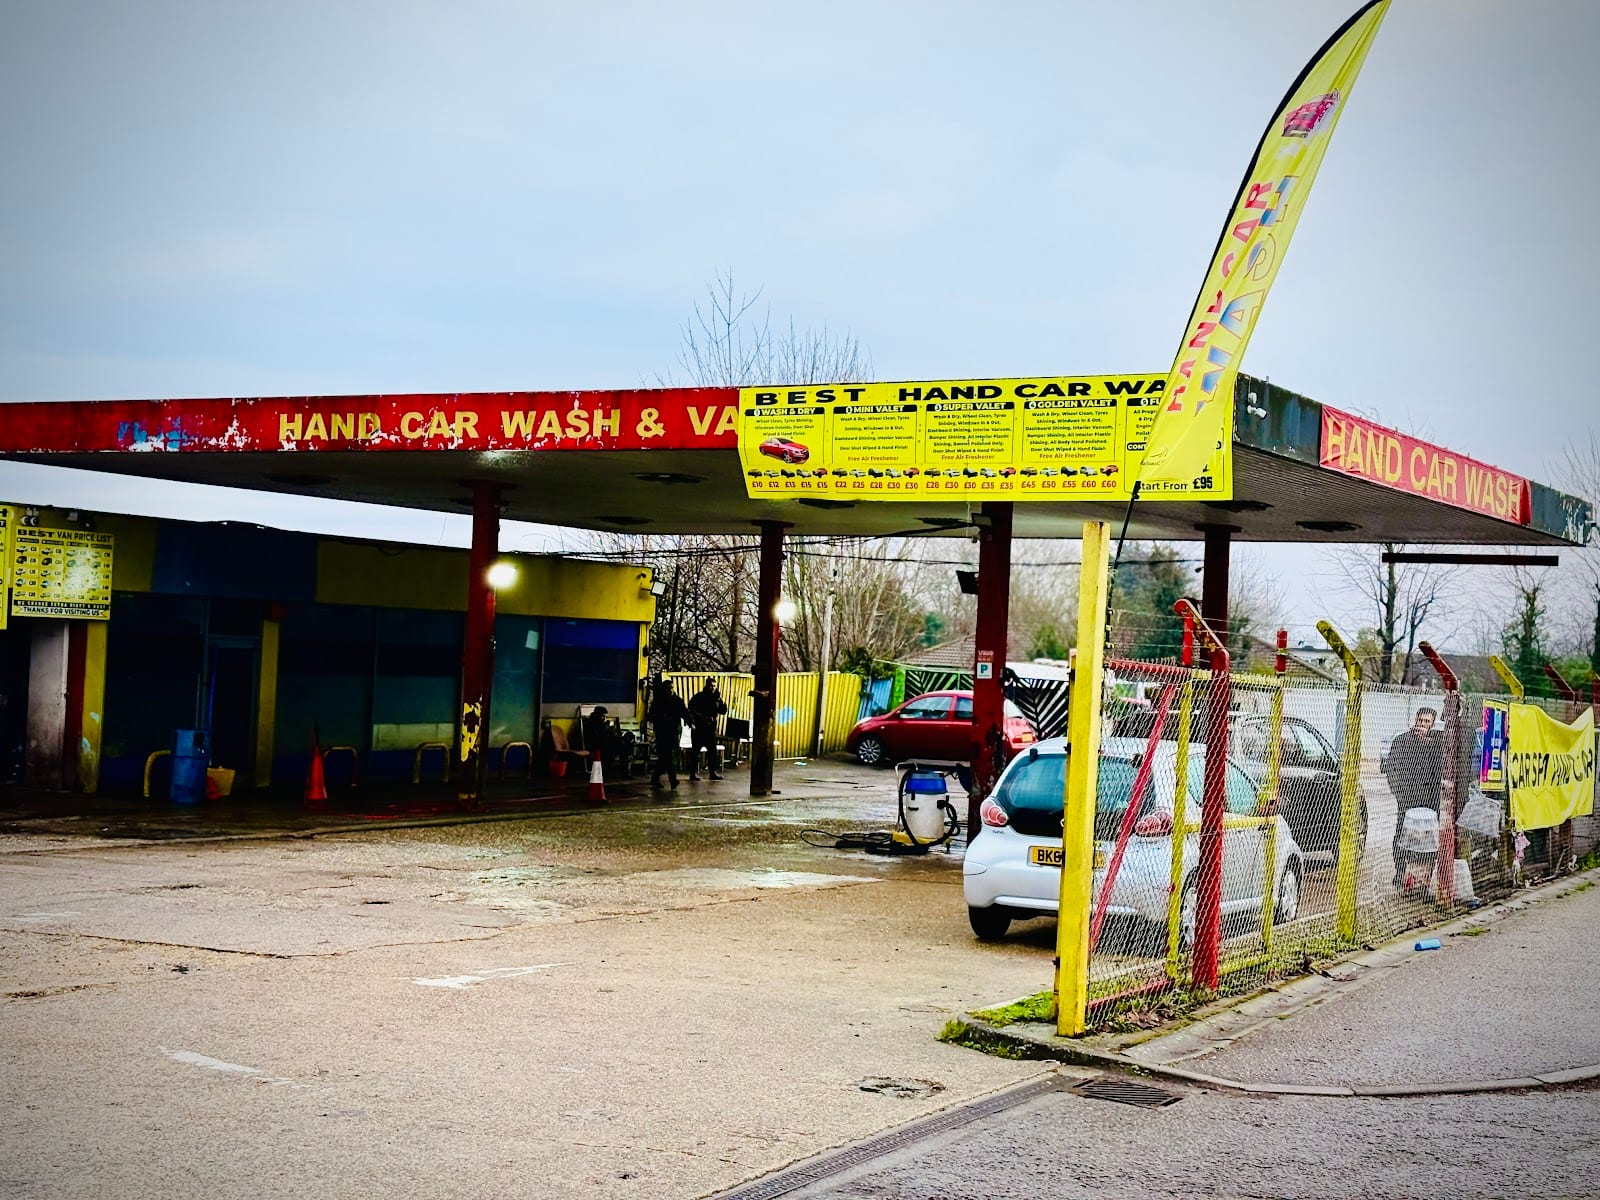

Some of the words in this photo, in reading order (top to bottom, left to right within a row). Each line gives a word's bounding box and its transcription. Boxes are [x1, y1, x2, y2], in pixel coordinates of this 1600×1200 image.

[756, 388, 865, 406] BEST
[898, 386, 1002, 401] HAND
[1014, 382, 1092, 398] CAR
[1104, 380, 1167, 395] WA
[279, 412, 380, 441] HAND
[401, 411, 479, 439] CAR
[501, 408, 620, 438] WASH
[636, 408, 665, 437] &
[1326, 417, 1403, 482] HAND
[1410, 447, 1458, 500] CAR
[1464, 466, 1521, 521] WASH
[1193, 477, 1212, 489] £95
[18, 529, 55, 537] BEST
[74, 533, 94, 541] PRICE
[1038, 849, 1060, 862] BK6
